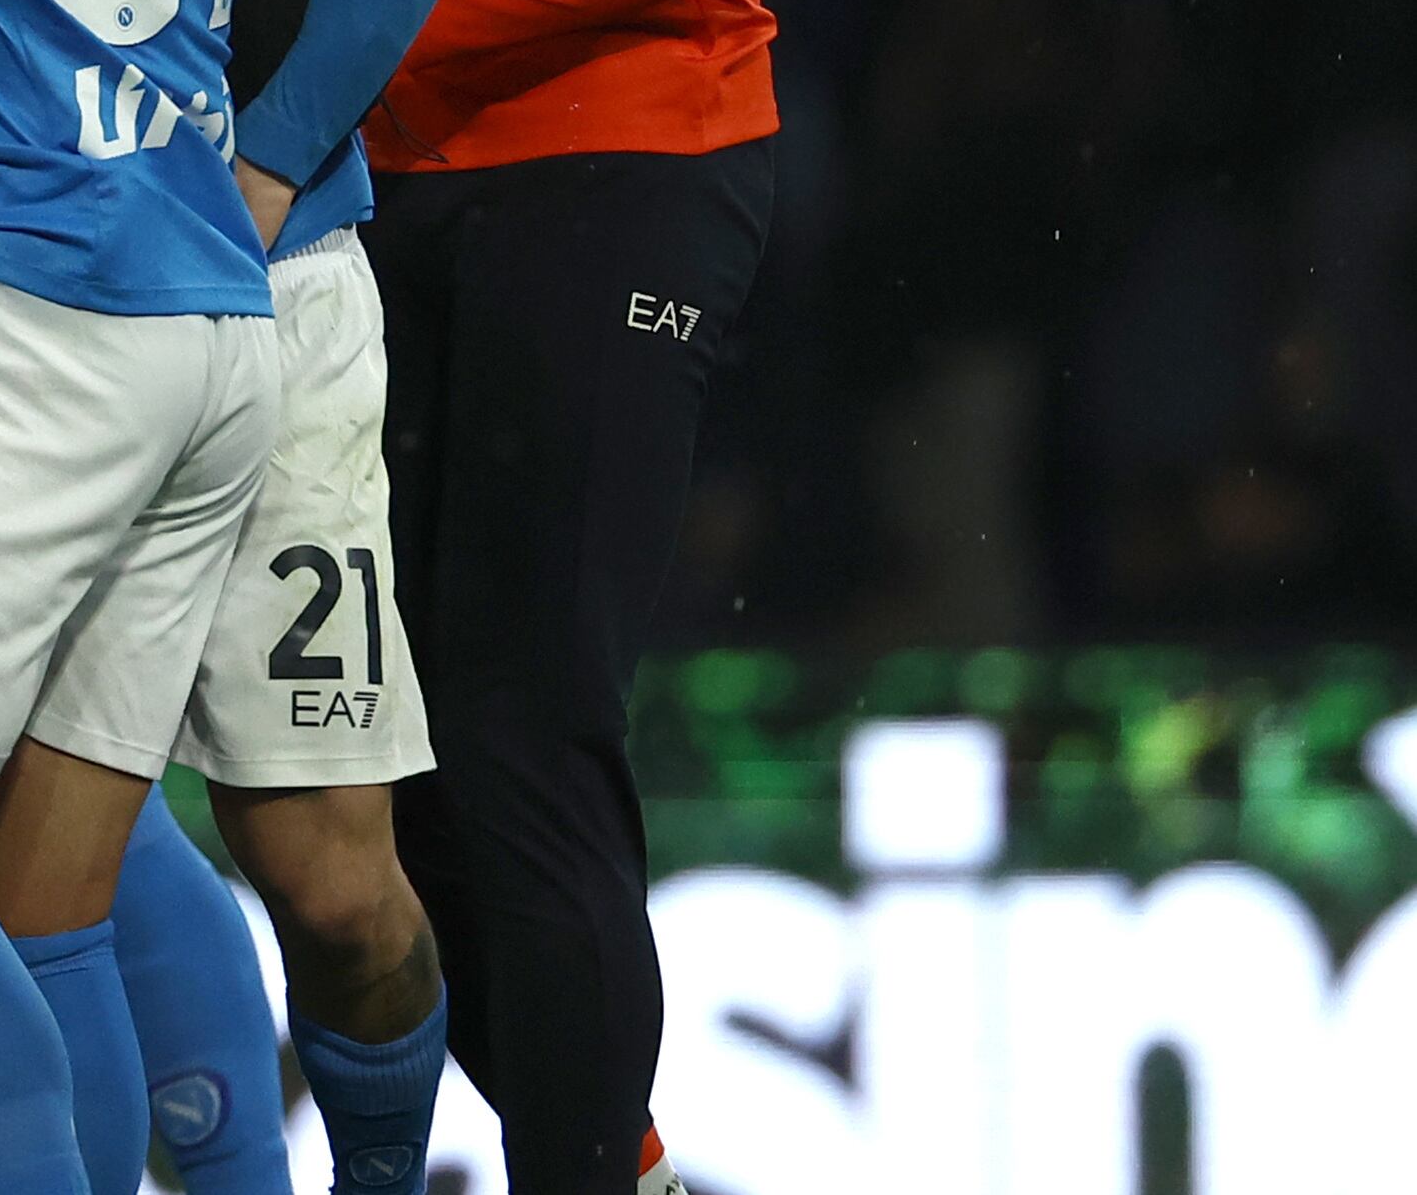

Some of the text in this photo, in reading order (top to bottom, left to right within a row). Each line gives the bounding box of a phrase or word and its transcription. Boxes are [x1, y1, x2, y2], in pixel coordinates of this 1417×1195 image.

[627, 291, 702, 342] EA7
[268, 544, 384, 685] 21
[292, 690, 380, 729] EA7
